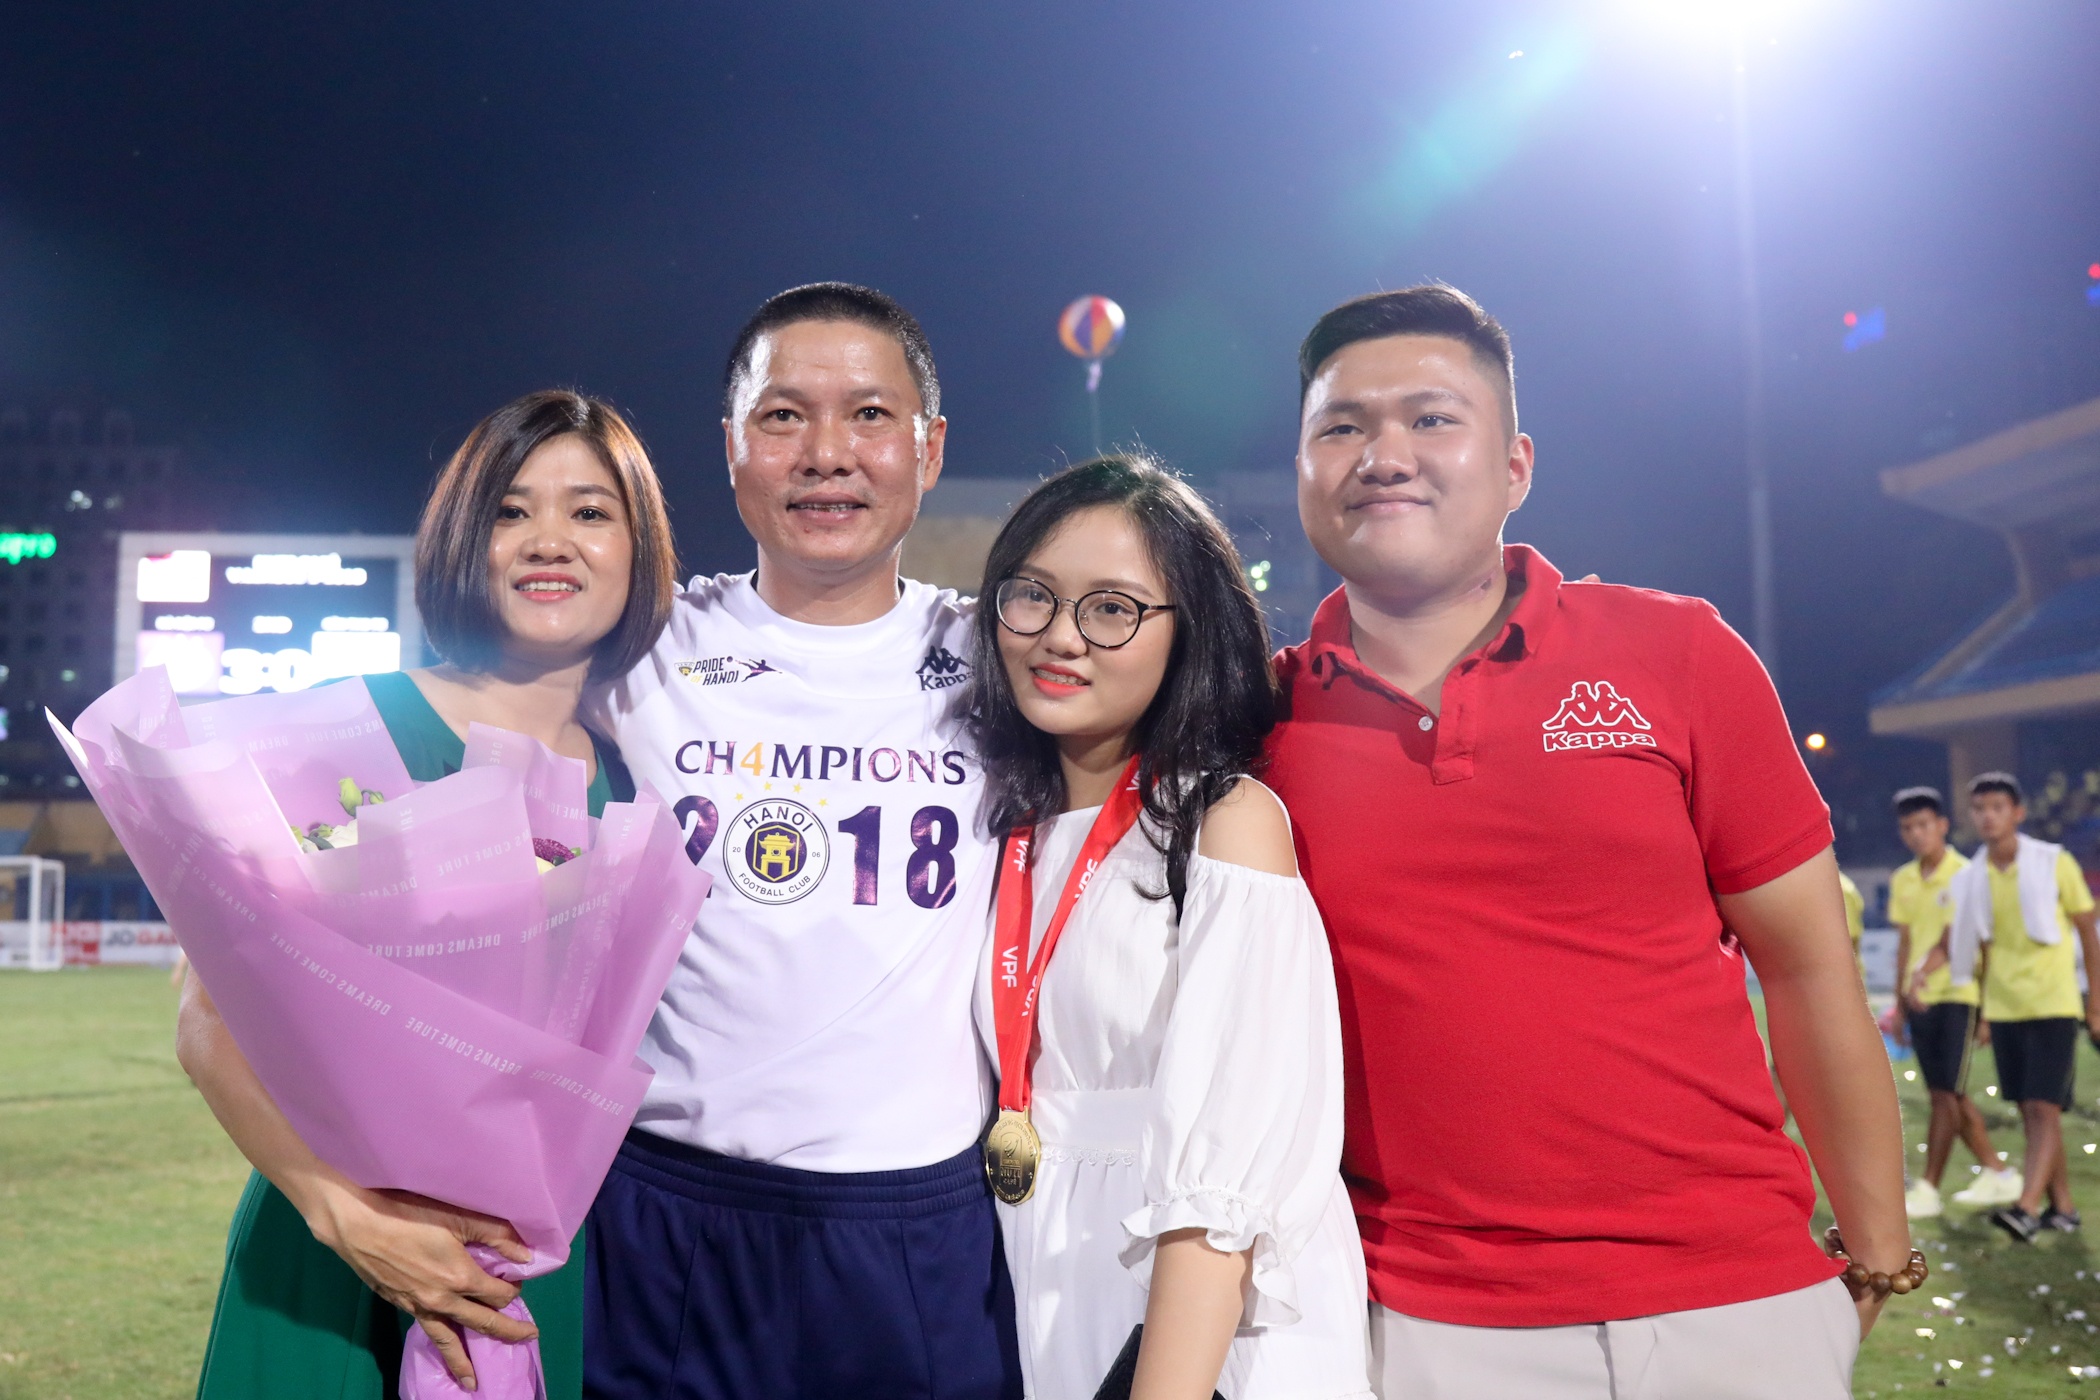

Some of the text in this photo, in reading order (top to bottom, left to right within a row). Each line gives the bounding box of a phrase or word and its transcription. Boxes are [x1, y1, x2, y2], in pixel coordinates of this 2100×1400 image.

[693, 657, 725, 674] PRIDE
[702, 670, 739, 686] HANOI
[919, 673, 971, 691] Kapp
[1543, 731, 1657, 752] Kappa
[675, 739, 967, 785] CH4MPIONS
[743, 806, 813, 832] HANOI
[738, 872, 811, 896] FOOTBALL CLUB
[1001, 945, 1019, 988] VPF
